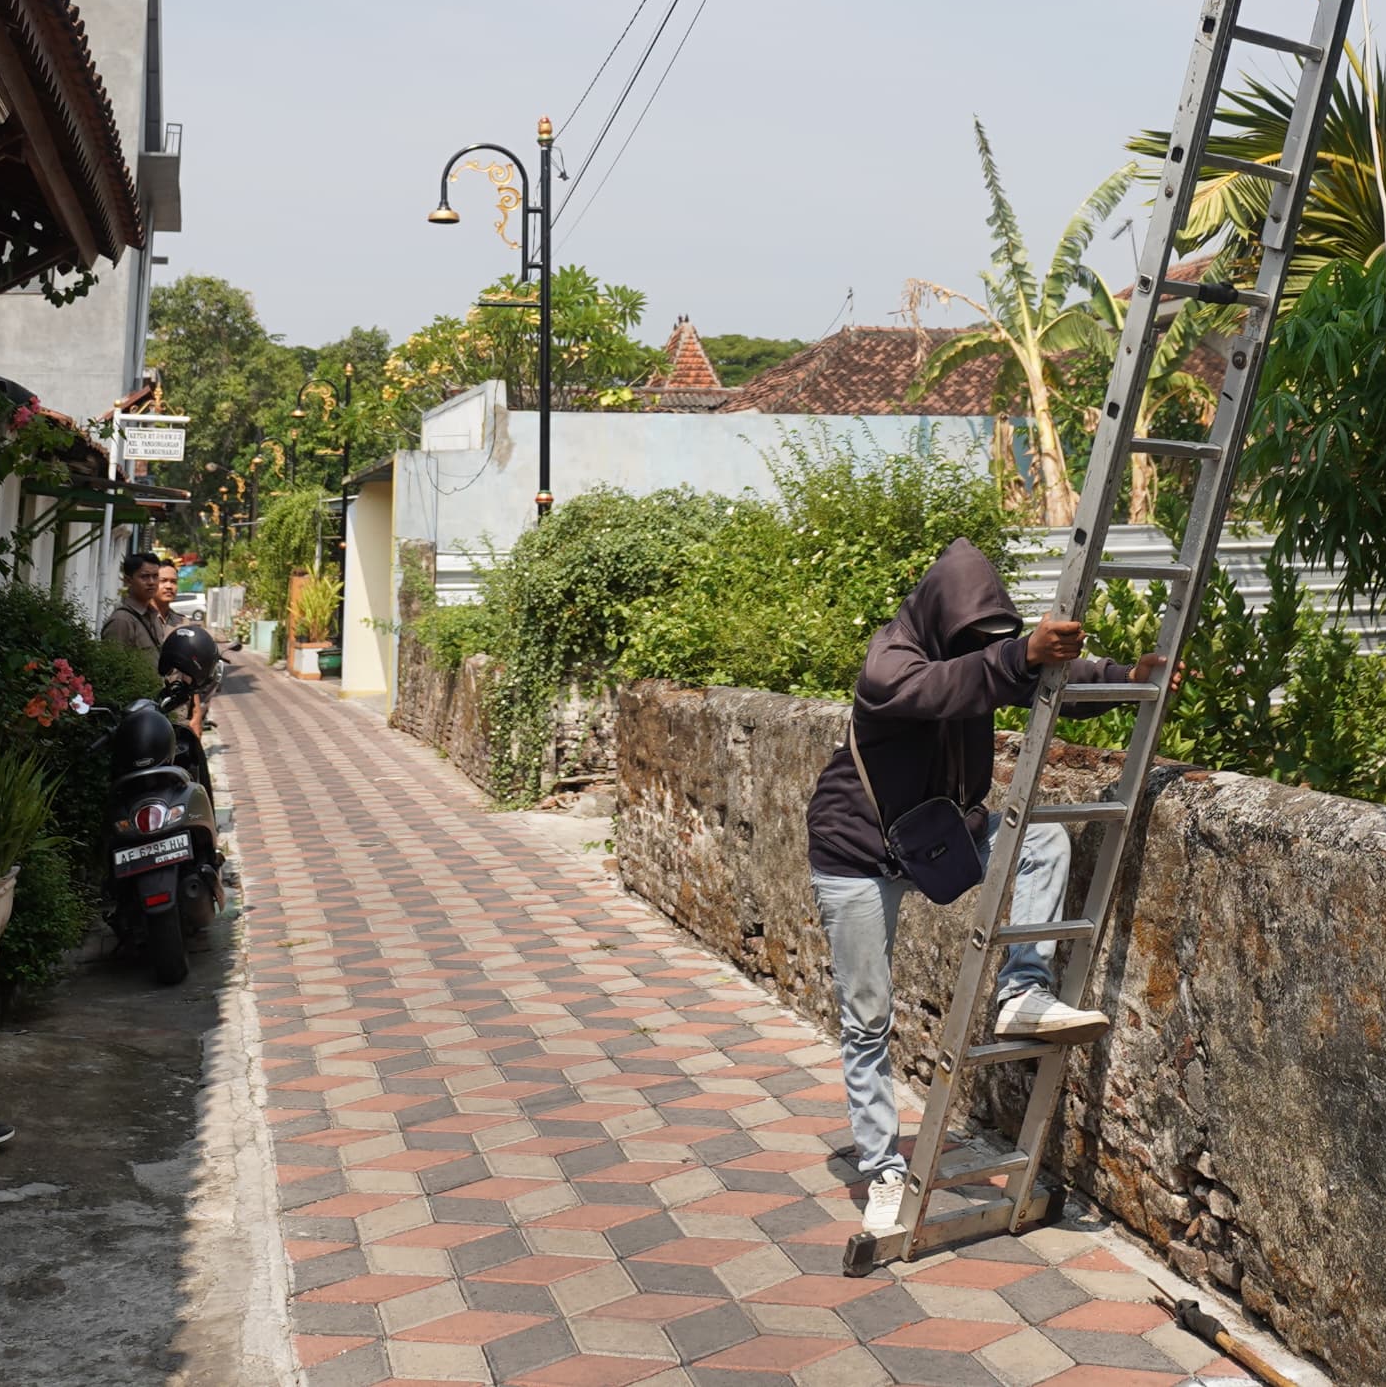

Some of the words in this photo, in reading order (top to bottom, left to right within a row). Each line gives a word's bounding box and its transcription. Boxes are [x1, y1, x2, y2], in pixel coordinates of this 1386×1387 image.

[121, 850, 134, 863] AE
[140, 842, 166, 857] 6295
[169, 837, 185, 850] HW
